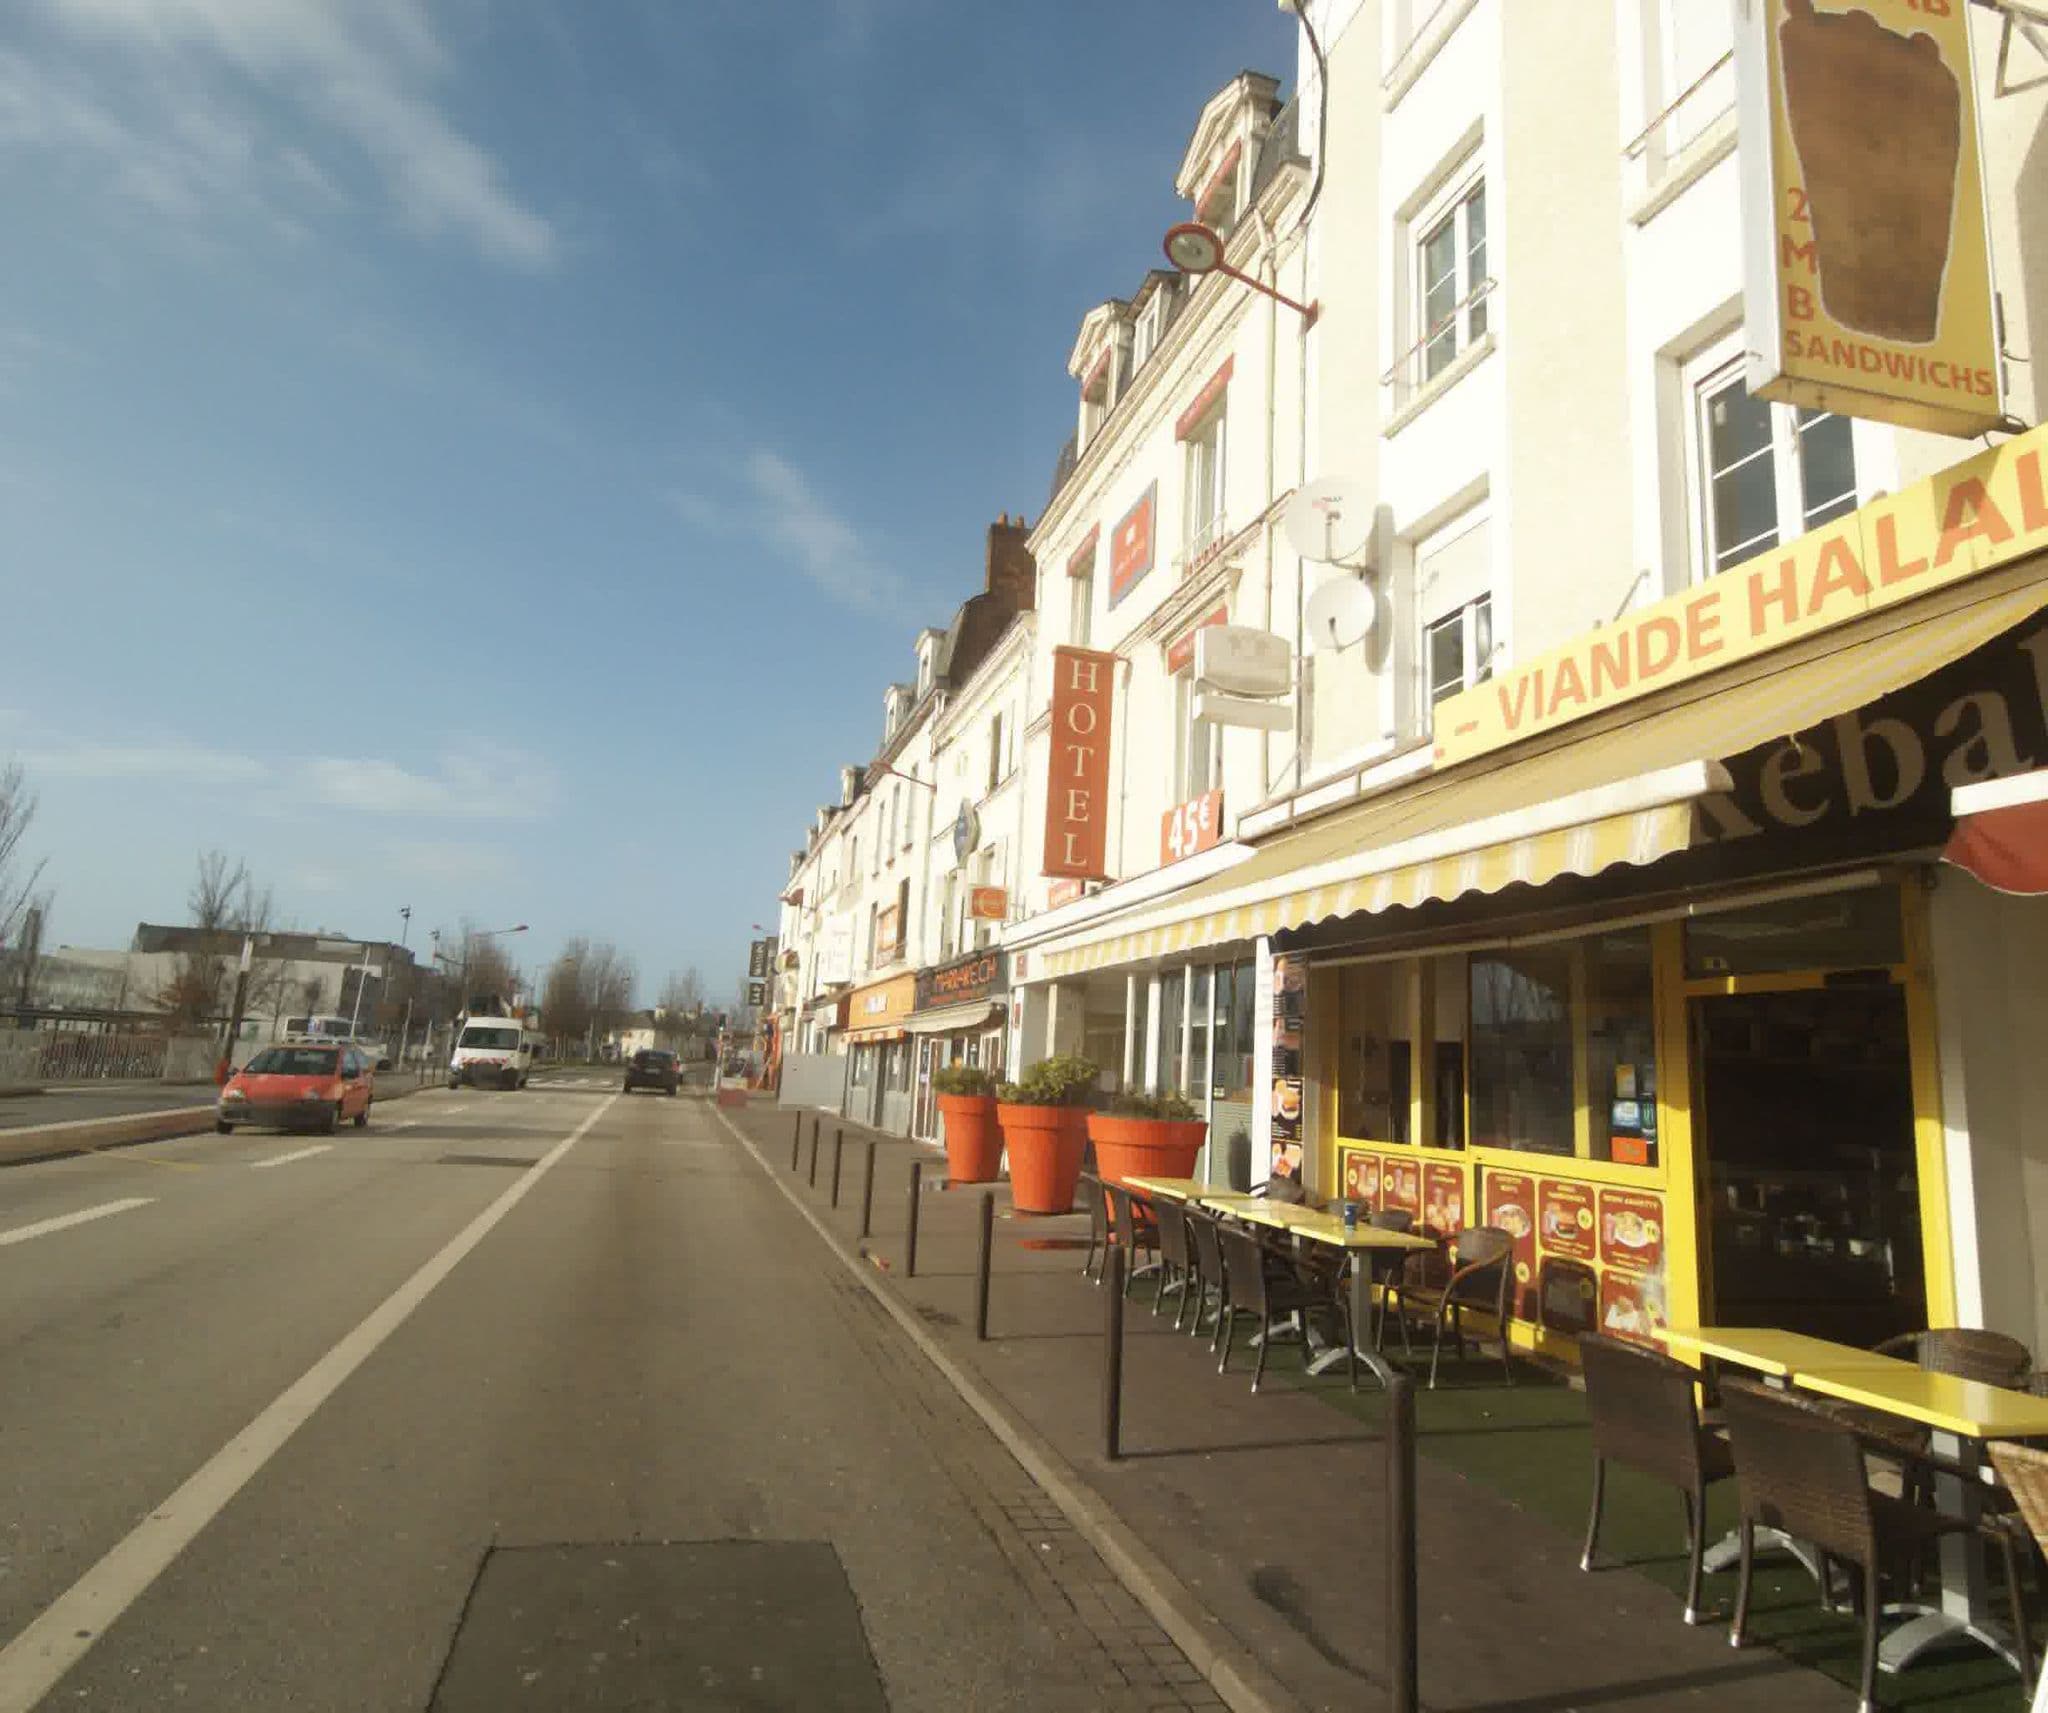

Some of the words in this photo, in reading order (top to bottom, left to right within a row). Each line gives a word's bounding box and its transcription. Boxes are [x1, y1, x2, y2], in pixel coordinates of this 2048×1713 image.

[1785, 329, 1994, 397] SANDWICHS
[1498, 592, 1724, 731] VIANDE
[1690, 628, 2048, 846] eba
[1063, 659, 1098, 867] HOTEL
